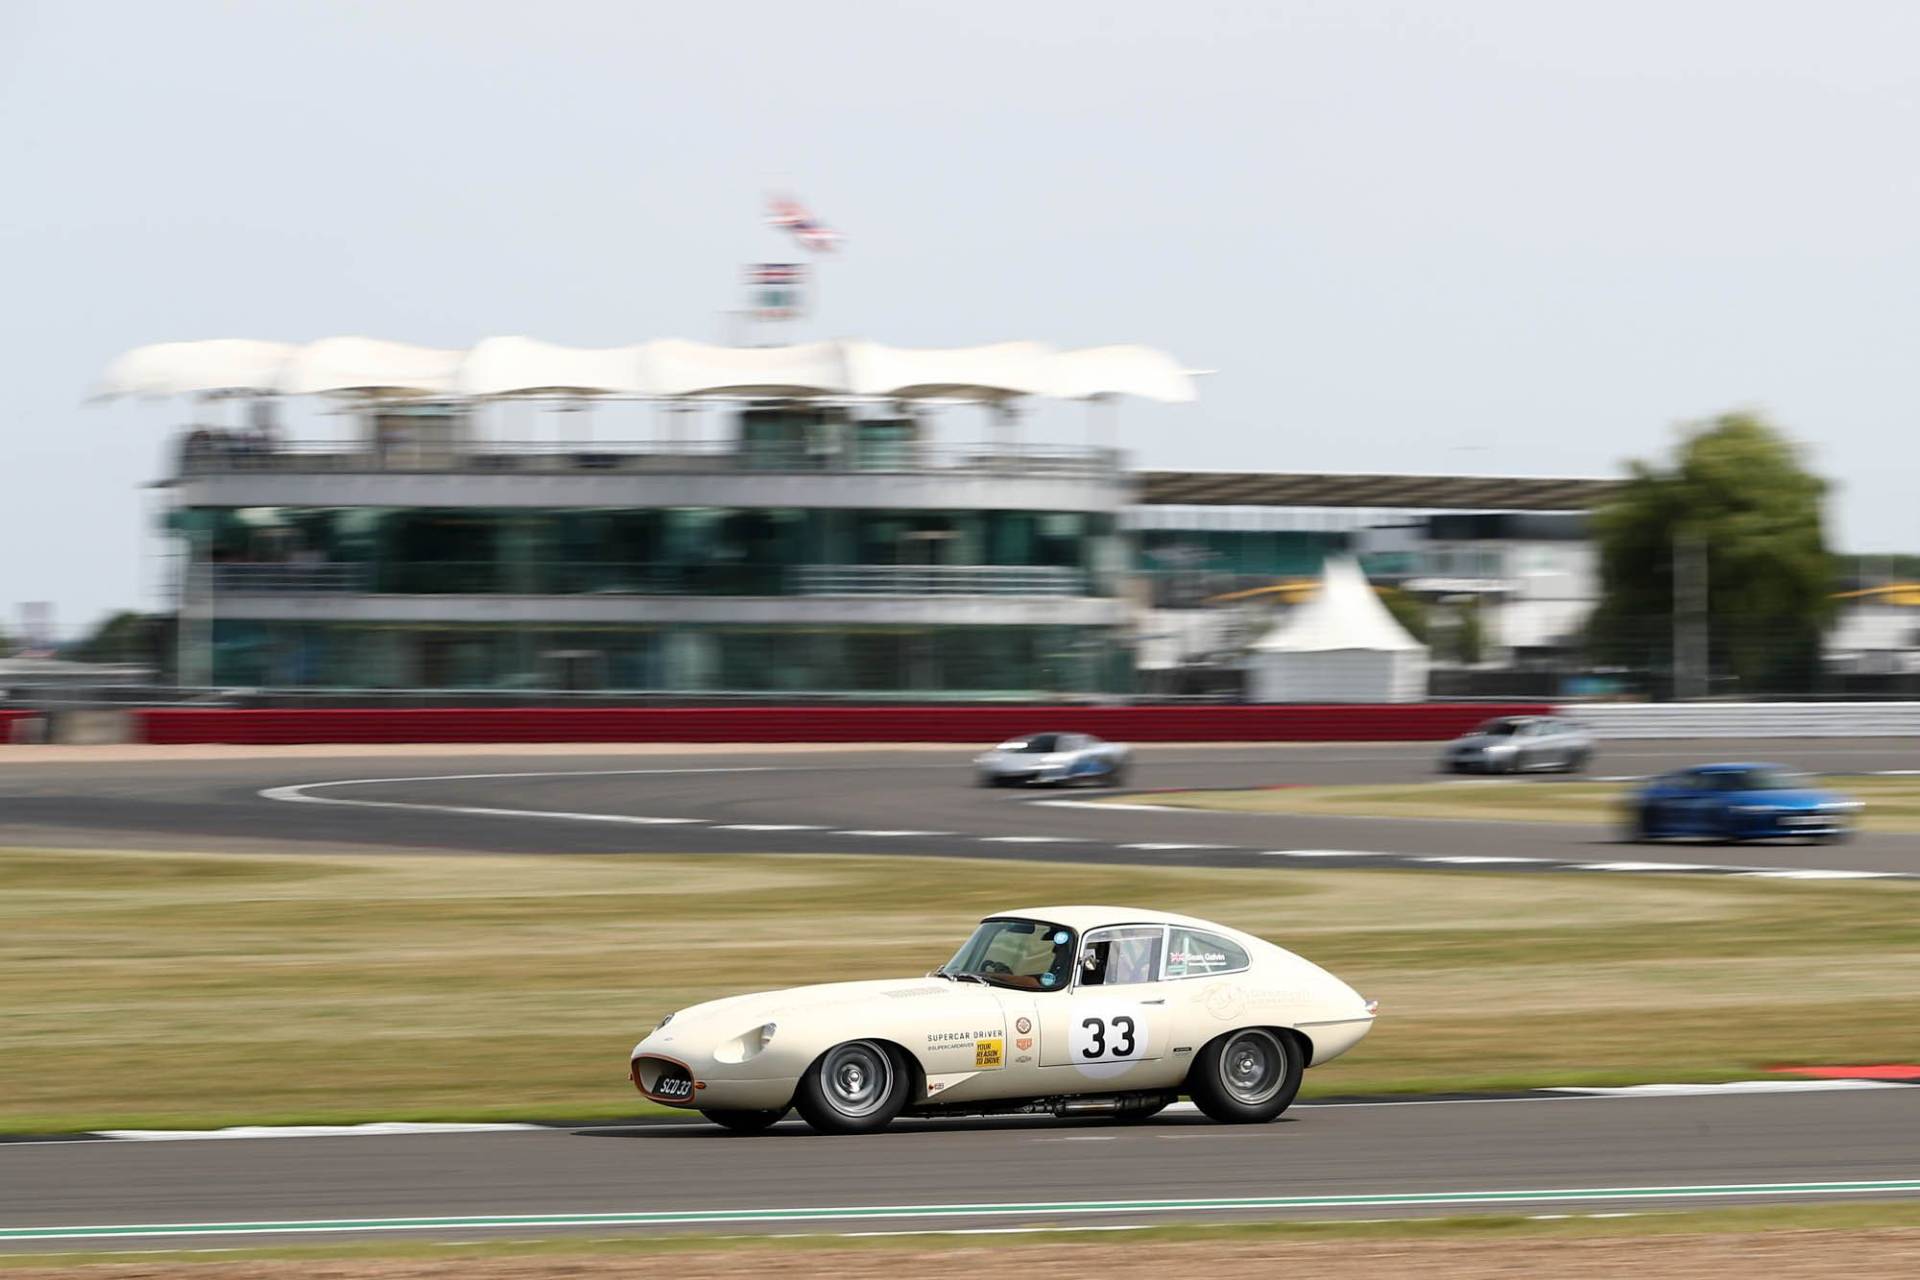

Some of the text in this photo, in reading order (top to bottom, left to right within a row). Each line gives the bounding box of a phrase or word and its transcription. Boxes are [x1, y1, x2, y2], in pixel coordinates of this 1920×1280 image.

[927, 1030, 1003, 1041] SUPERCAR DRIVER
[1082, 1015, 1136, 1059] 33
[977, 1043, 992, 1051] YOUR
[660, 1078, 692, 1095] SCD 33
